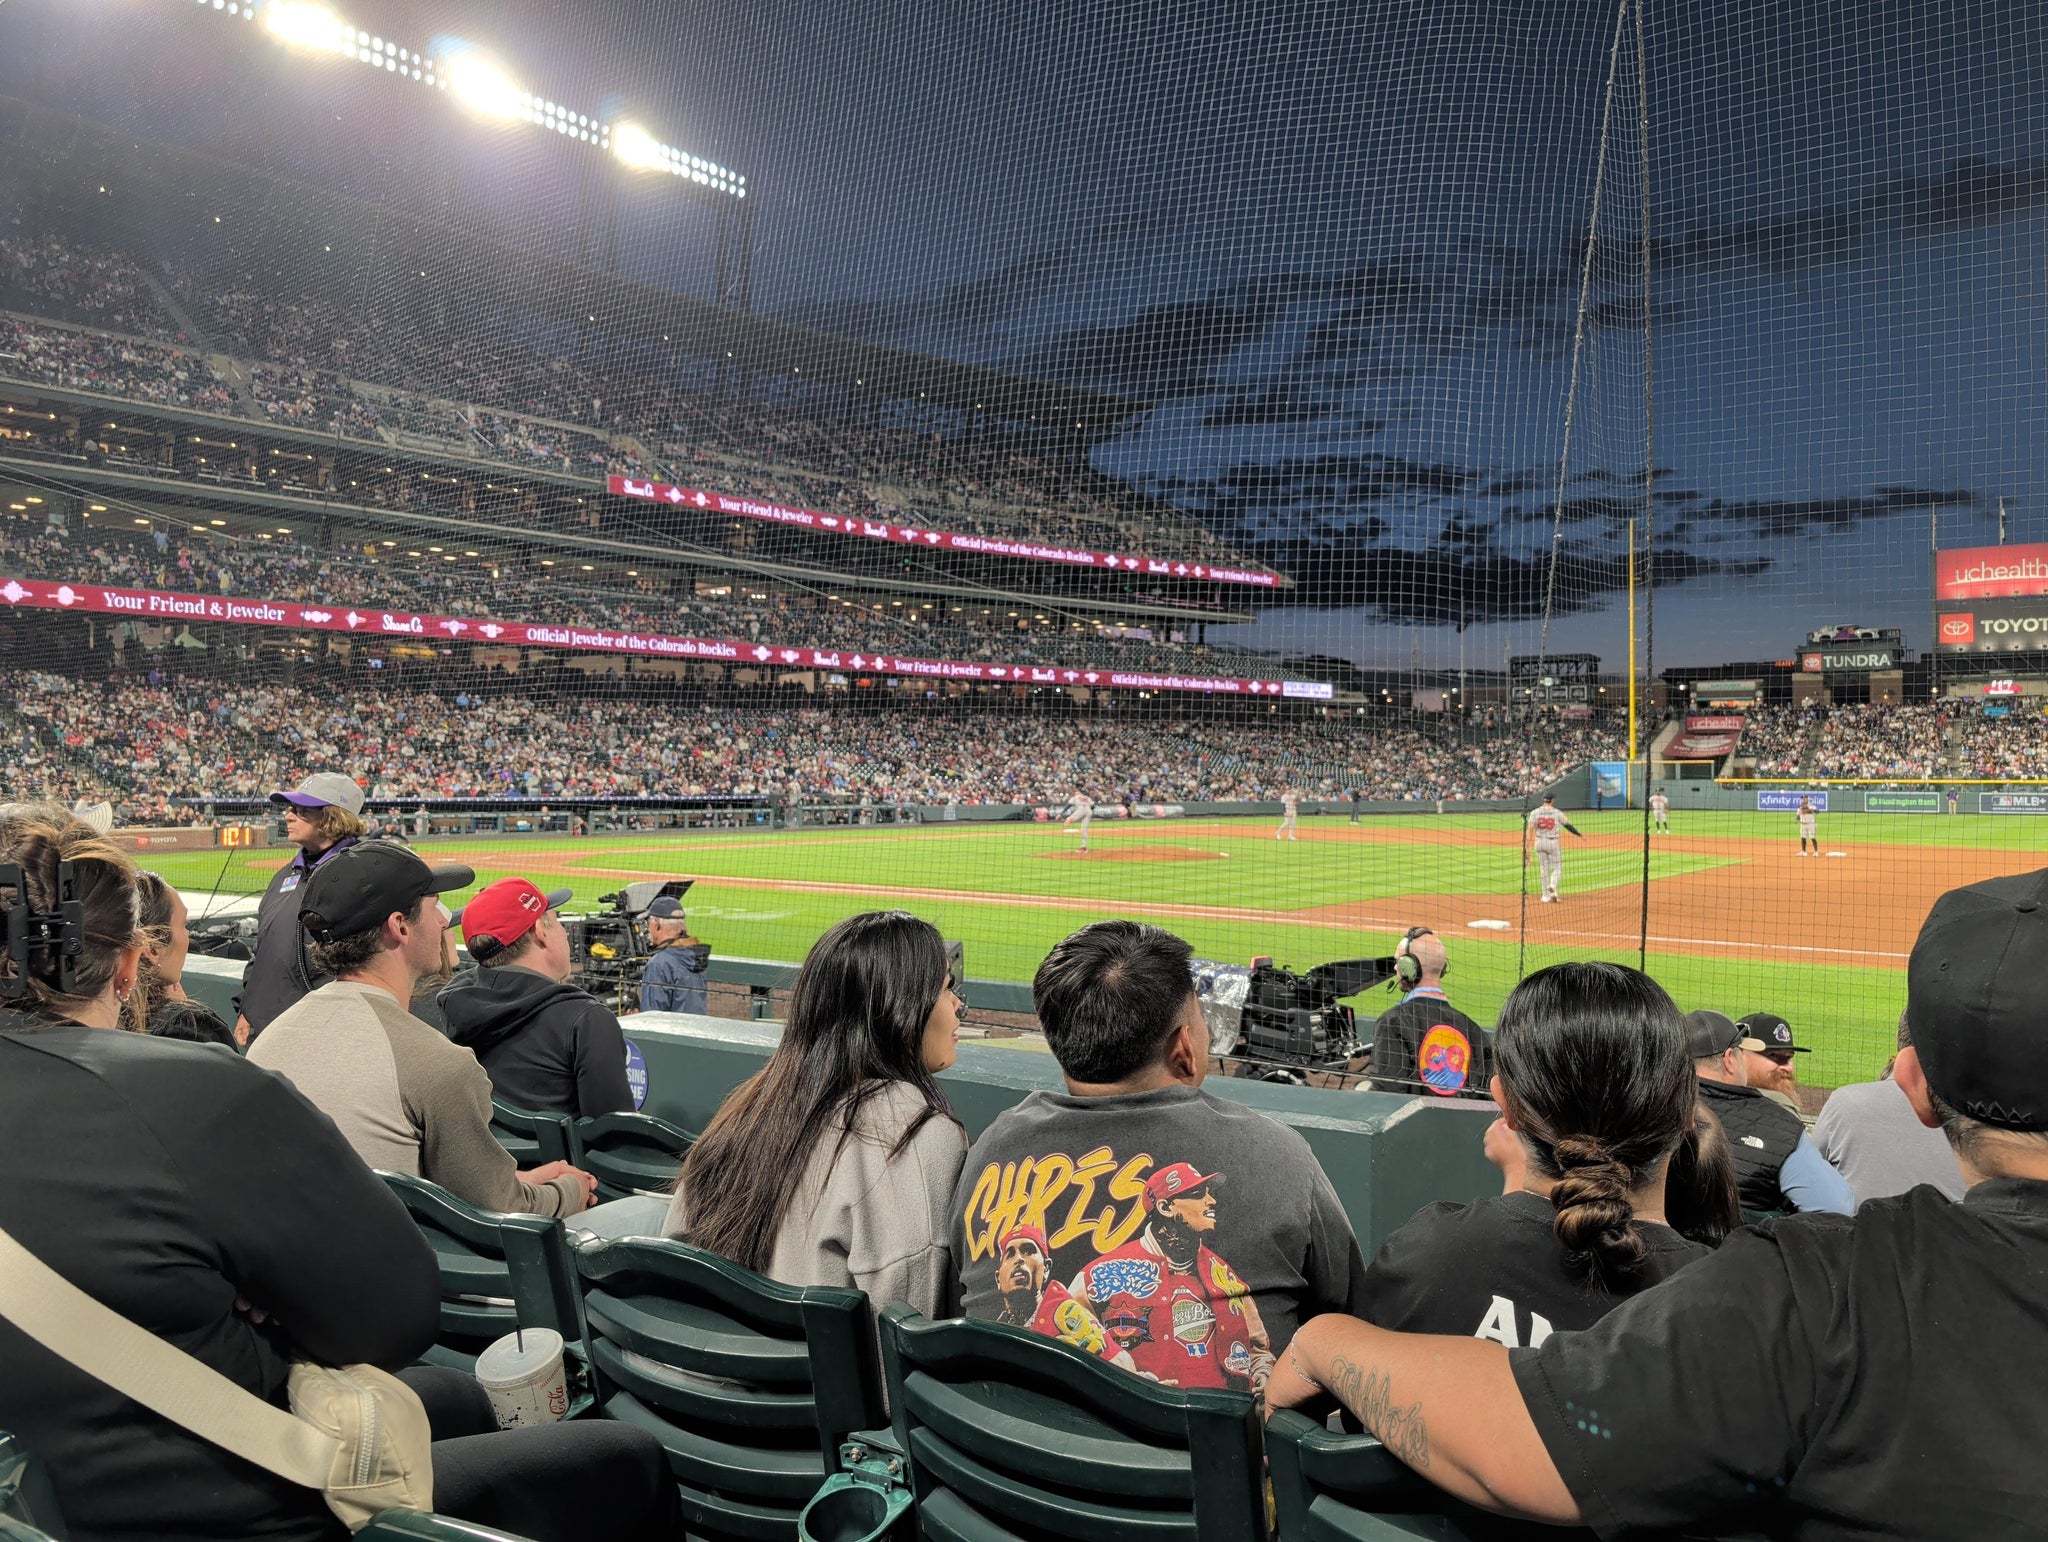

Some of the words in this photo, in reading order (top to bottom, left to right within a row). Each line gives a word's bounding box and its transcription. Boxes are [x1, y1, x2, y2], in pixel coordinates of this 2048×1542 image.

[719, 498, 741, 511] Your
[742, 502, 772, 517] Friend
[773, 508, 781, 518] &
[782, 508, 813, 525] Jeweler
[1956, 557, 2048, 584] uchealth
[104, 592, 144, 609] Your
[150, 596, 205, 614] Friend
[210, 602, 223, 615] &
[226, 603, 285, 620] Jeweler
[383, 614, 410, 631] Shane
[527, 628, 569, 643] Official
[572, 631, 613, 648] Jeweler
[615, 635, 627, 648] of
[629, 636, 647, 649] the
[649, 637, 696, 653] Colorado
[698, 642, 736, 656] Rockies
[895, 660, 913, 671] Your
[915, 662, 941, 673] Friend
[943, 664, 950, 673] &
[951, 665, 982, 676] Jeweler
[1823, 653, 1891, 668] TUNDRA
[1692, 717, 1740, 730] uchealth
[1761, 795, 1791, 805] xfinity
[1793, 796, 1824, 805] mbile
[150, 836, 177, 844] TOYOTA
[964, 1146, 1154, 1262] CHRIS
[548, 1384, 567, 1415] Cola
